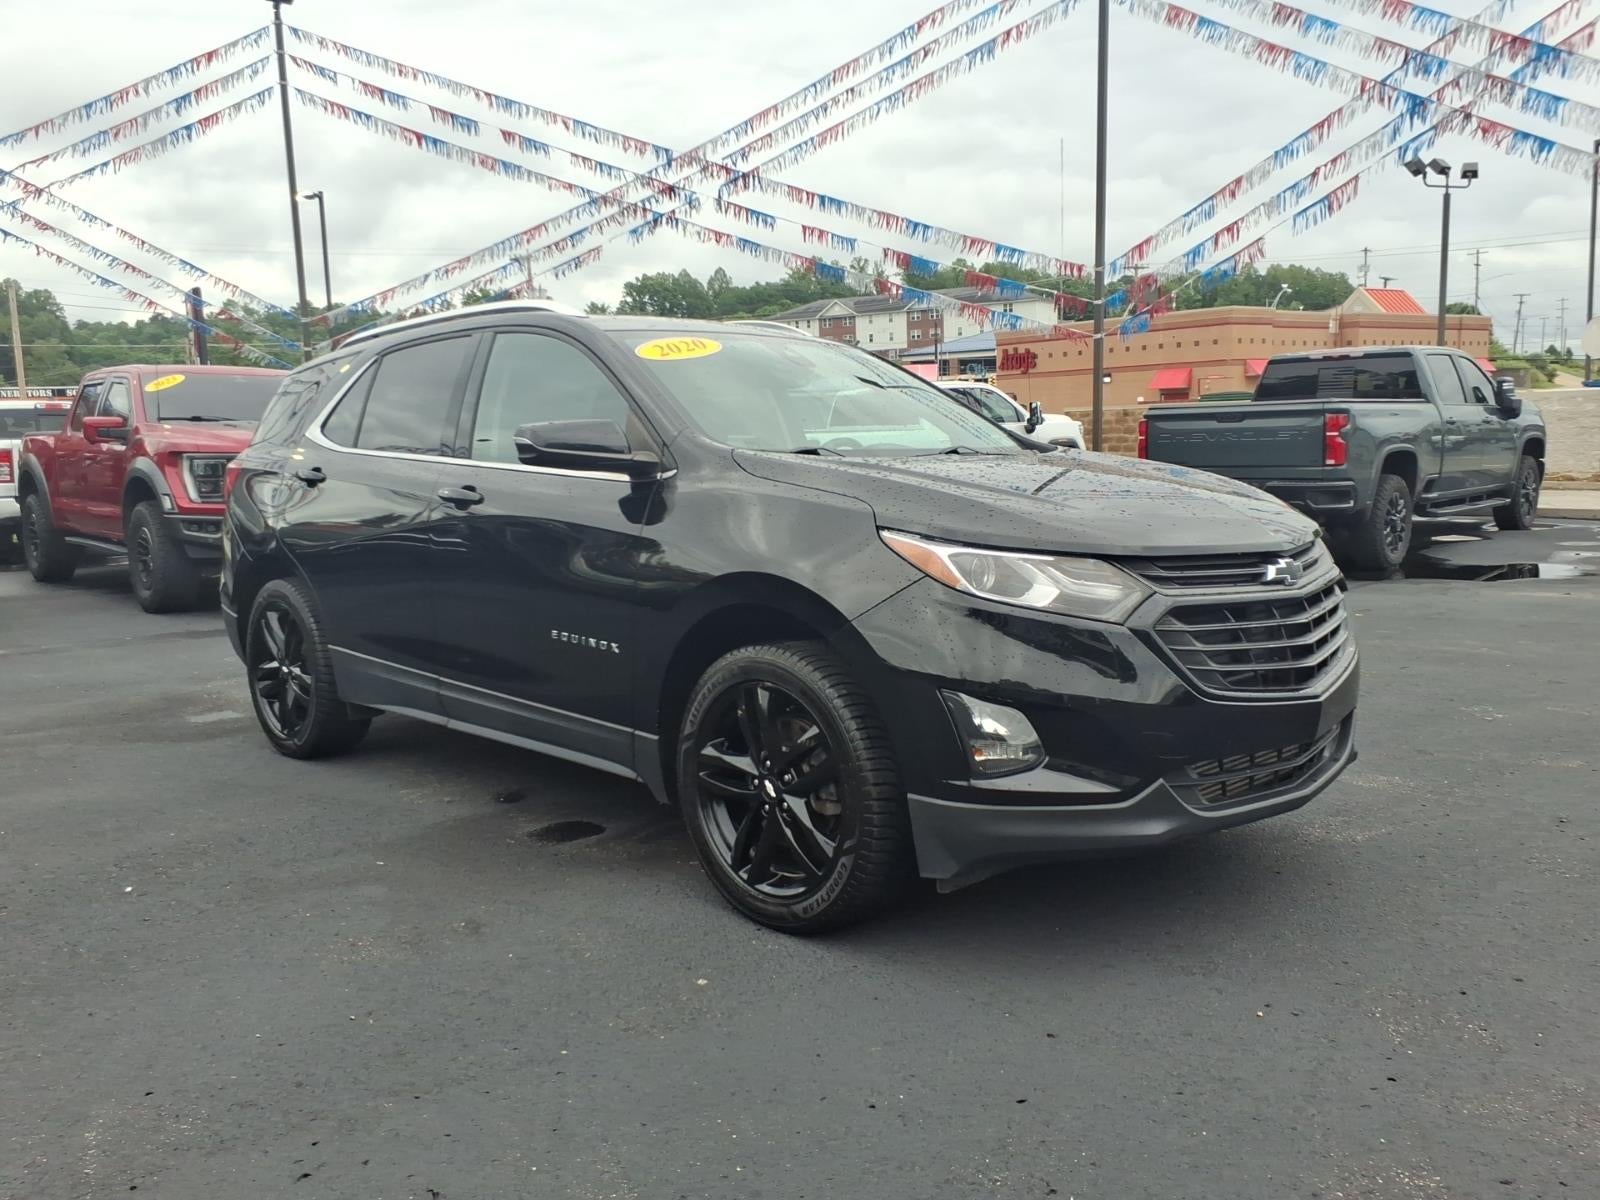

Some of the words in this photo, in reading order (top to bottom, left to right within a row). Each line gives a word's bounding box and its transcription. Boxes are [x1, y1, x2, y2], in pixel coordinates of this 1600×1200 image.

[652, 339, 707, 357] 2020
[1157, 431, 1310, 443] CHEVROLET
[551, 629, 620, 654] EQUINOX
